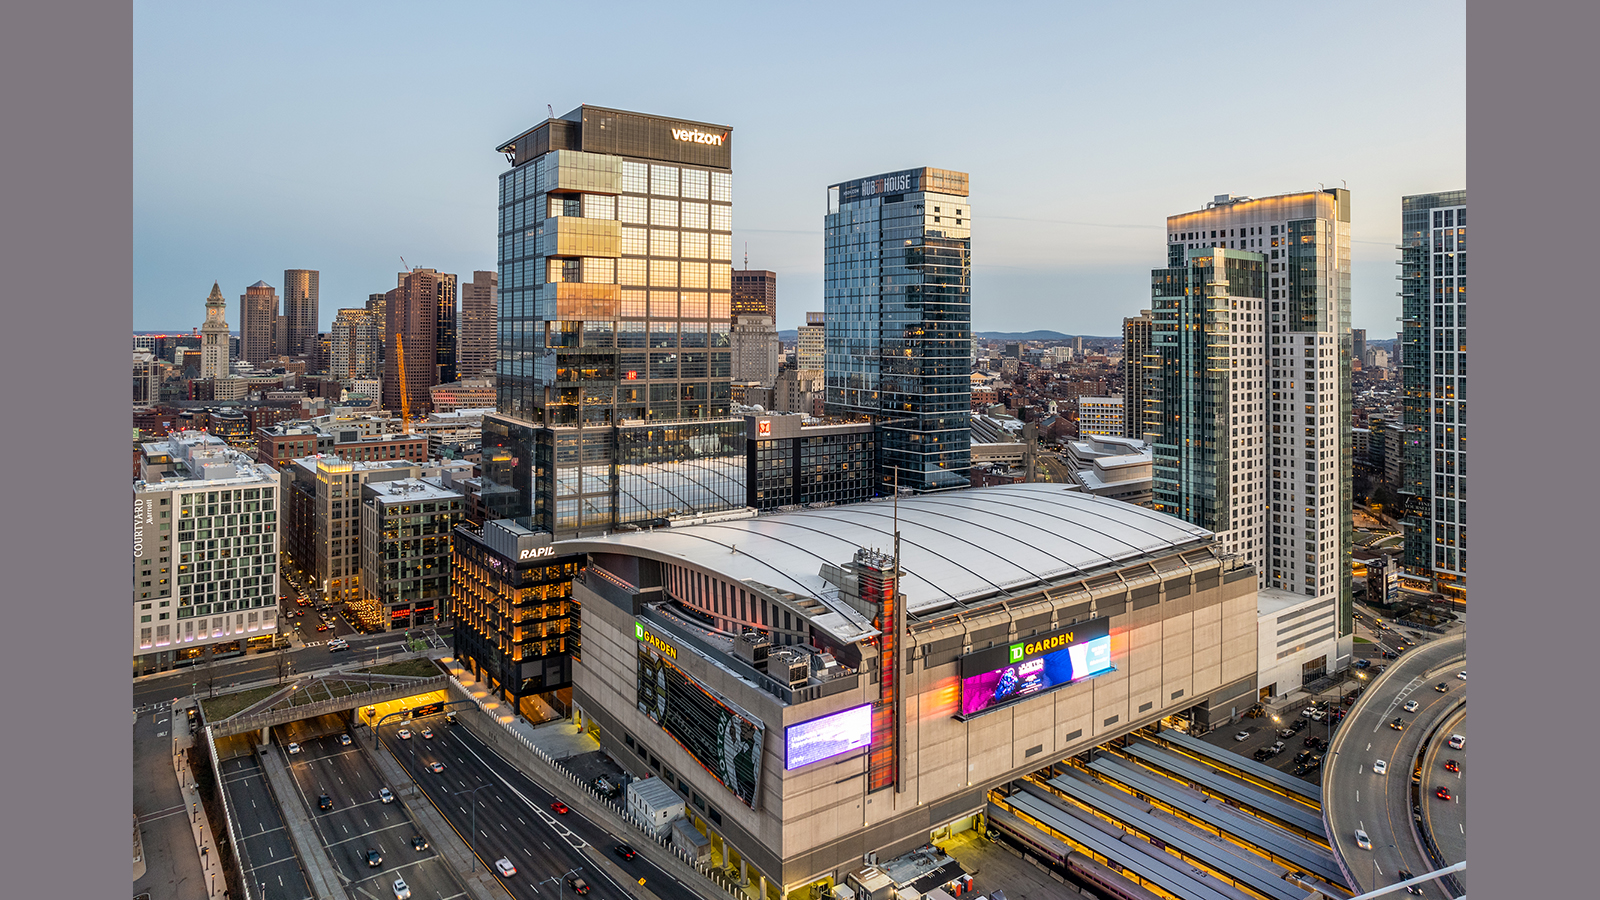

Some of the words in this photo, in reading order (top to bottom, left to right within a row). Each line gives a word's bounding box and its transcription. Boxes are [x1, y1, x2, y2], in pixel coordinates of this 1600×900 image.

[671, 128, 722, 146] verizon
[133, 498, 144, 558] COURTYARD
[643, 631, 677, 660] GARDEN
[1025, 631, 1074, 656] GARDEN
